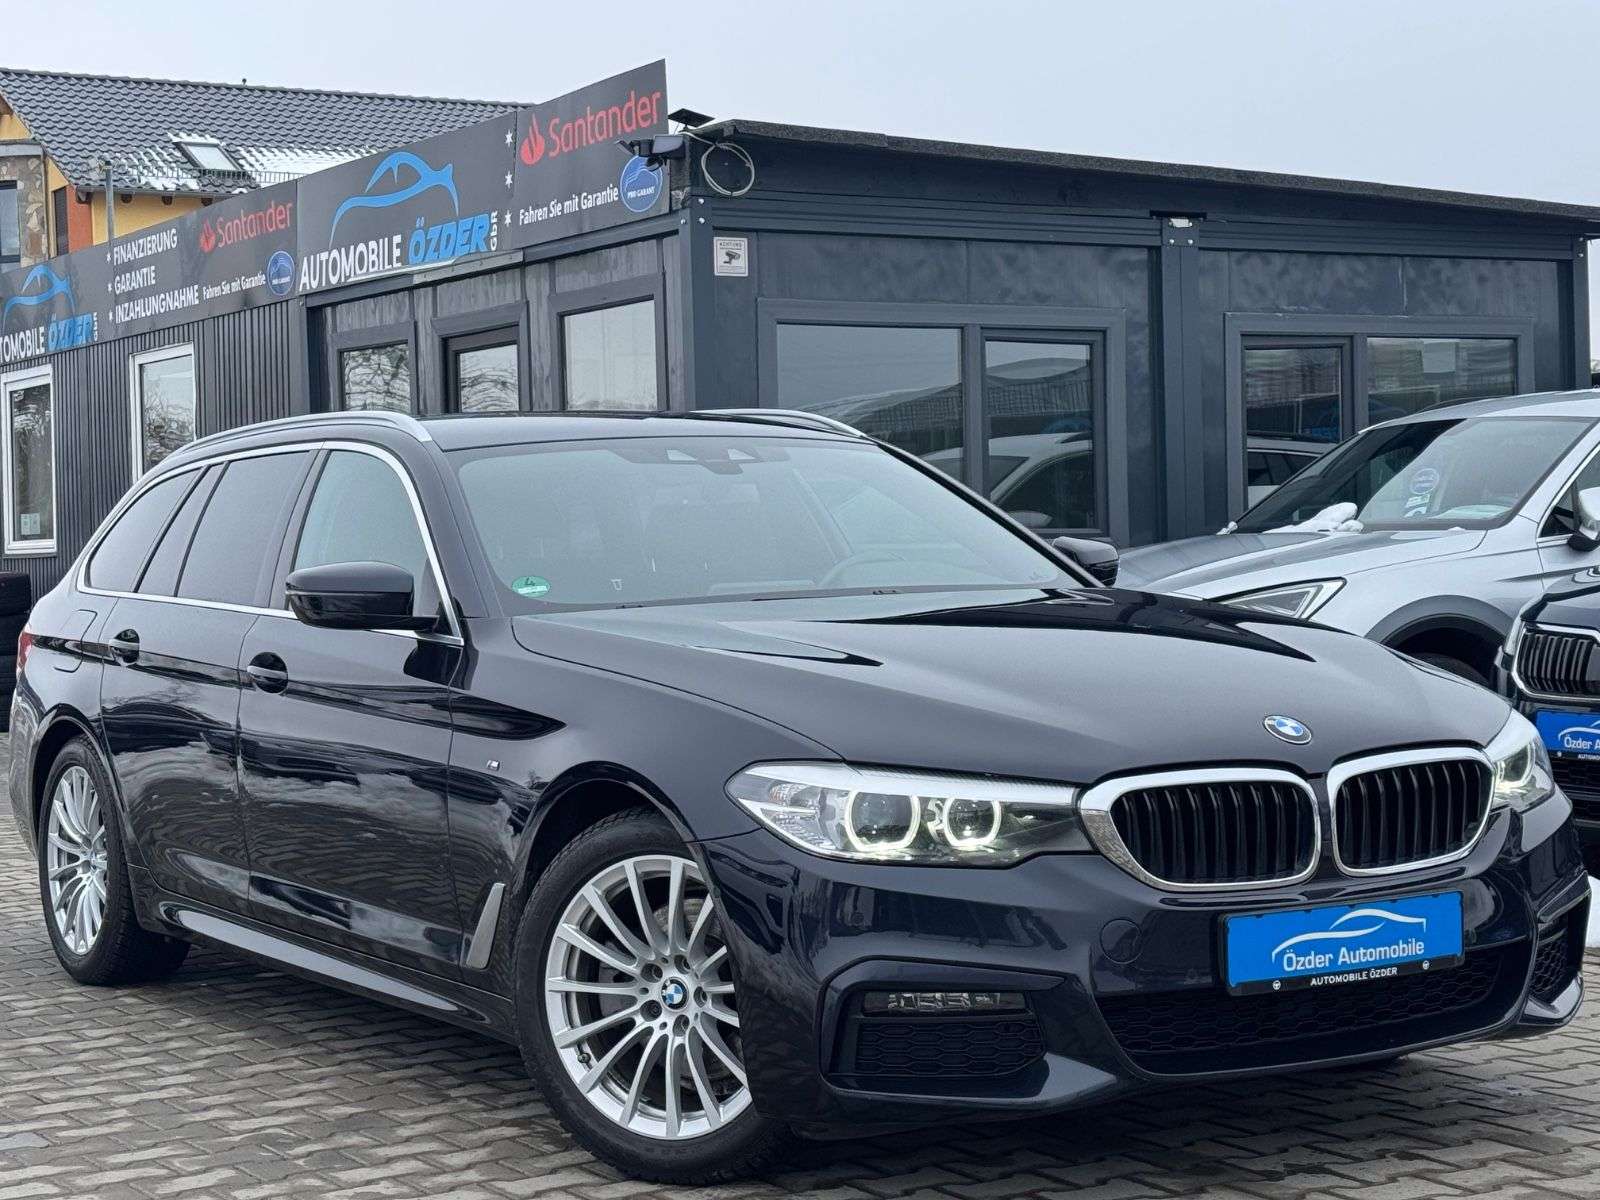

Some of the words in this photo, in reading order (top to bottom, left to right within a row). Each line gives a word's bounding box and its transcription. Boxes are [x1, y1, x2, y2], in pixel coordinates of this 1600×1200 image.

[549, 90, 661, 158] Santander
[216, 200, 293, 247] Santander
[519, 207, 548, 226] Fahren
[549, 199, 562, 217] Sie
[564, 194, 579, 212] mit
[581, 183, 619, 210] Garantie
[113, 228, 178, 266] FINANZIERUNG
[490, 210, 498, 251] GbR
[300, 235, 402, 291] AUTOMOBILE
[408, 213, 490, 266] ÖZDER
[114, 265, 156, 295] GARANTIE
[202, 286, 221, 300] Fahren
[221, 281, 231, 295] Sie
[241, 272, 266, 290] Garantie
[115, 284, 199, 324] INZAHLUNGNAHME
[1564, 734, 1593, 749] Özder
[1283, 949, 1334, 972] Özder
[1337, 938, 1425, 966] Automobile
[1310, 970, 1368, 987] AUTOMOBILE
[1369, 966, 1398, 979] ÖZDER
